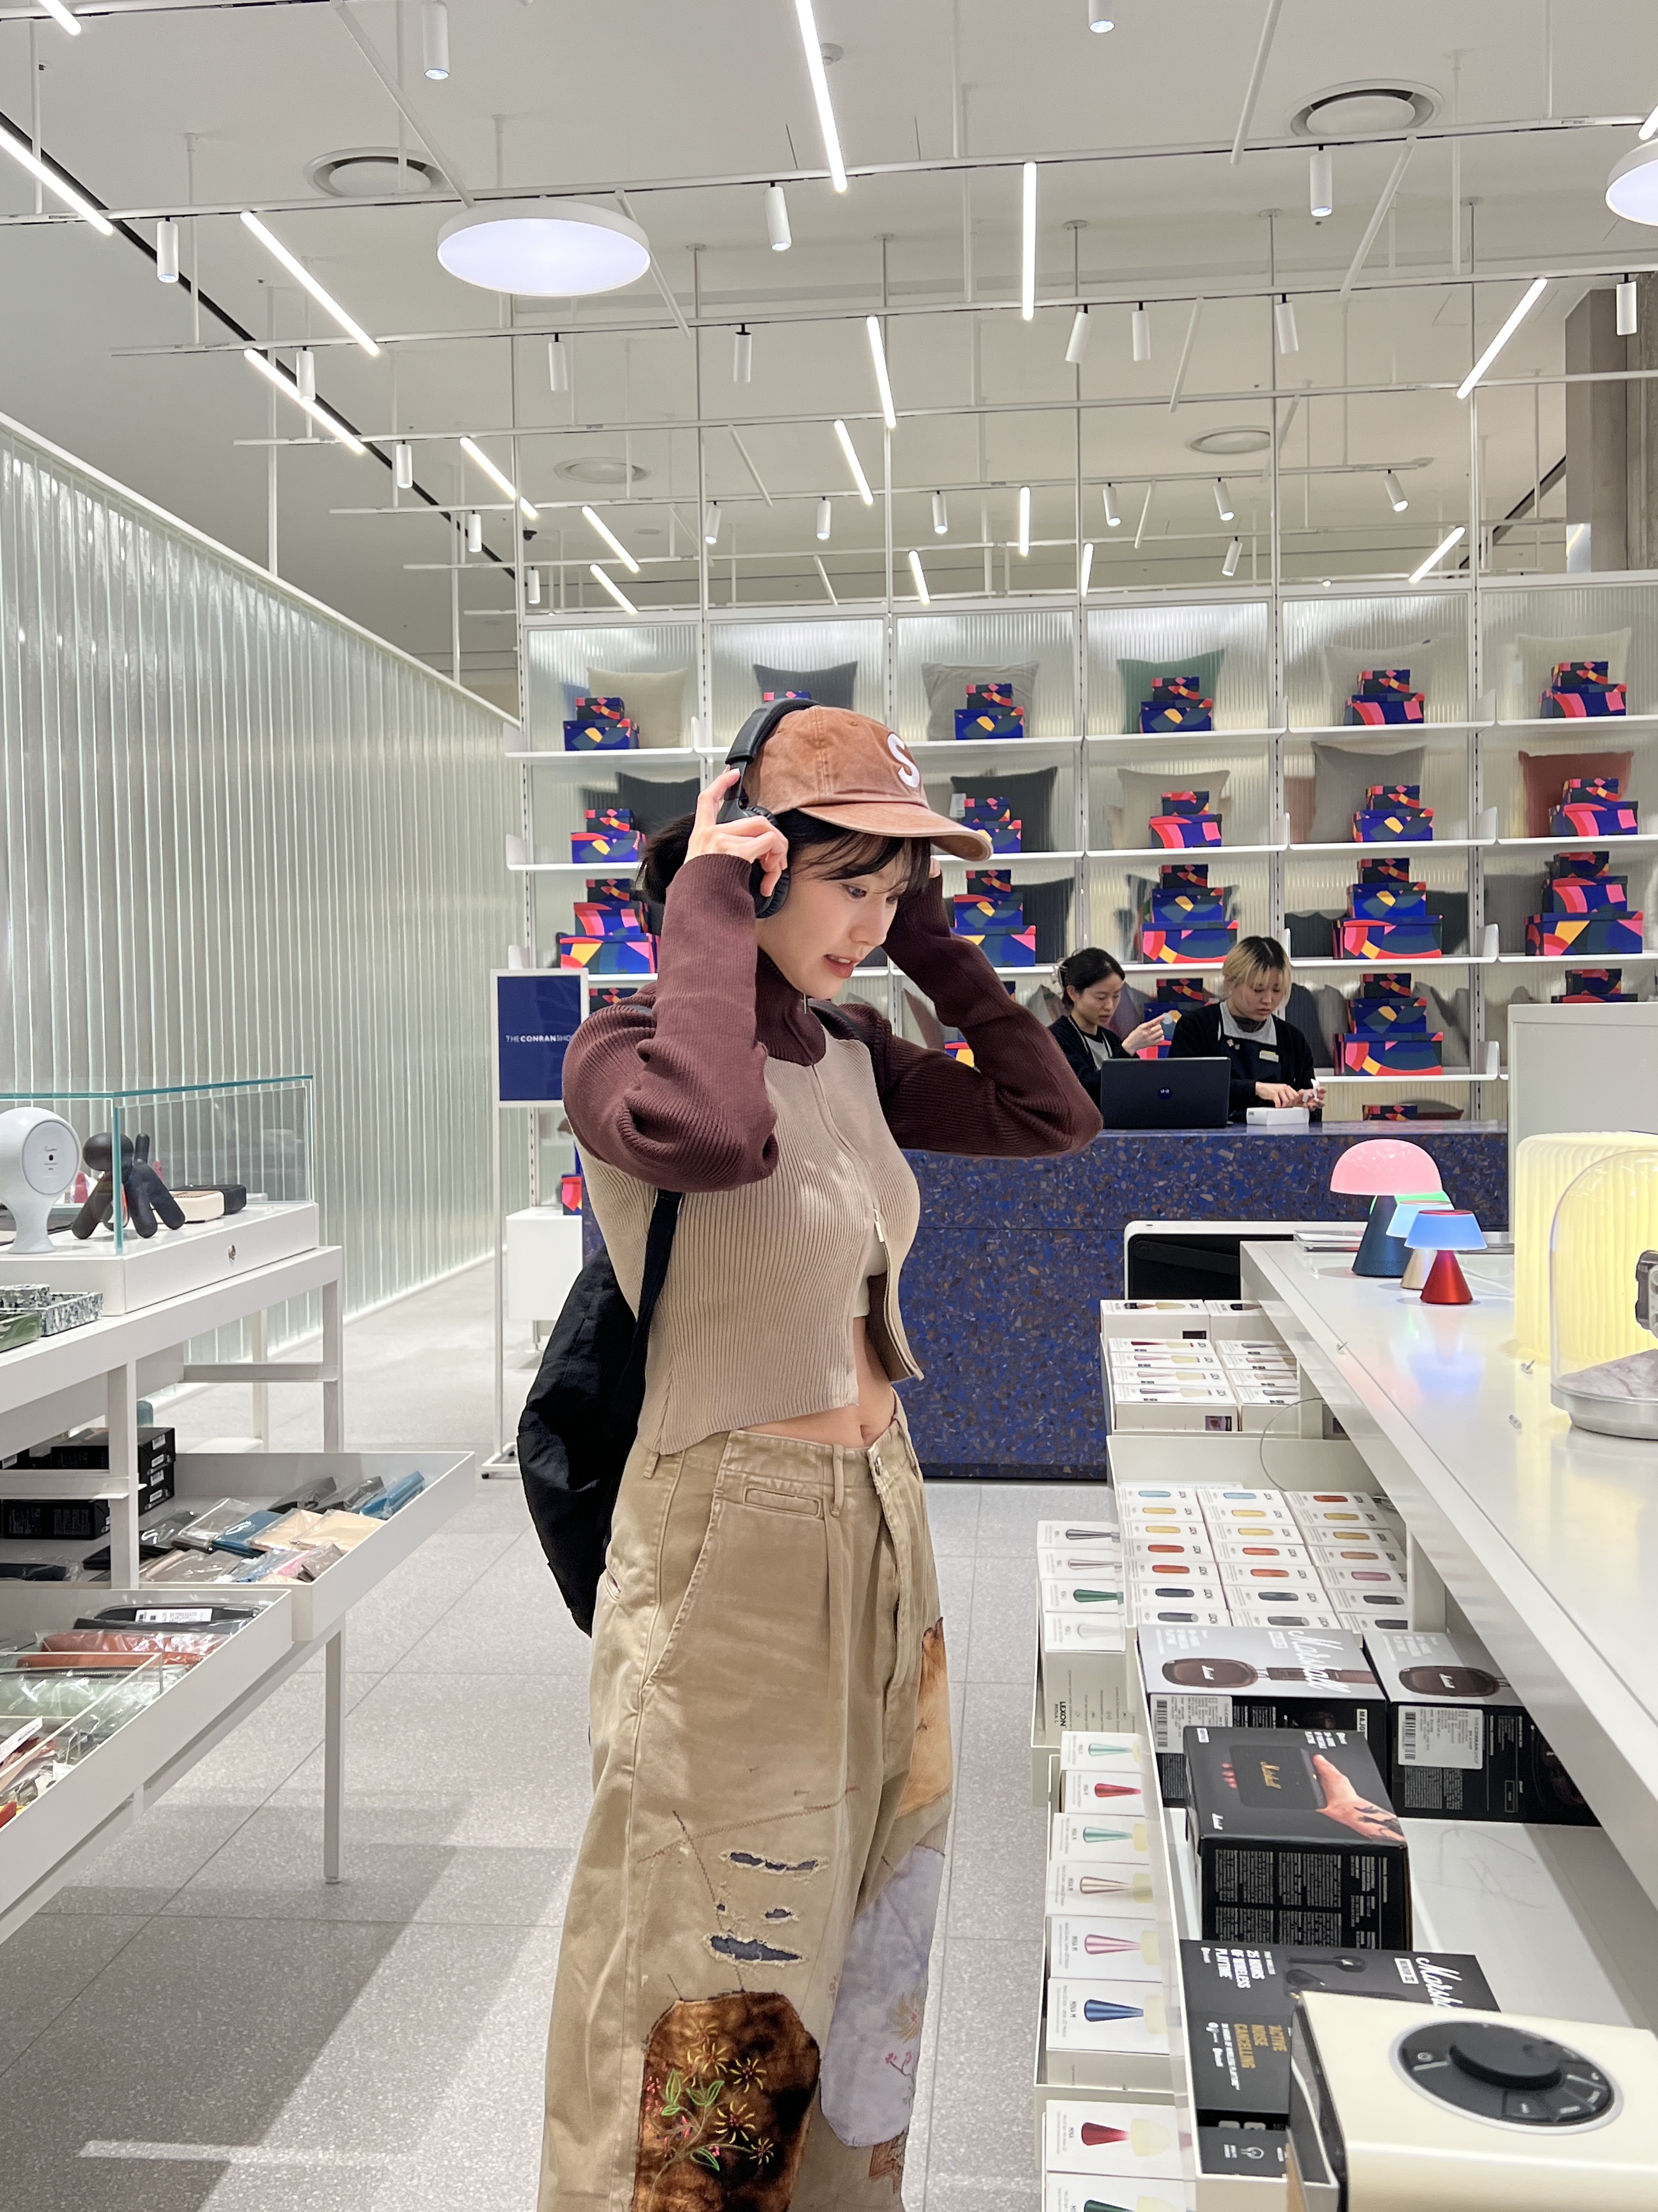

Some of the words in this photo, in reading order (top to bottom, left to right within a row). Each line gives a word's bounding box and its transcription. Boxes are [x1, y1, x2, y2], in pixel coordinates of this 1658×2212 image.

[887, 733, 920, 788] S
[1288, 1630, 1351, 1693] Marshall
[1231, 1949, 1244, 1957] OF
[1247, 1950, 1260, 1959] 25
[1233, 1958, 1251, 1989] WIRELESS
[1234, 2024, 1256, 2068] CANCELLING
[1251, 2024, 1268, 2046] NOISE
[1268, 2025, 1287, 2052] ACTIVE
